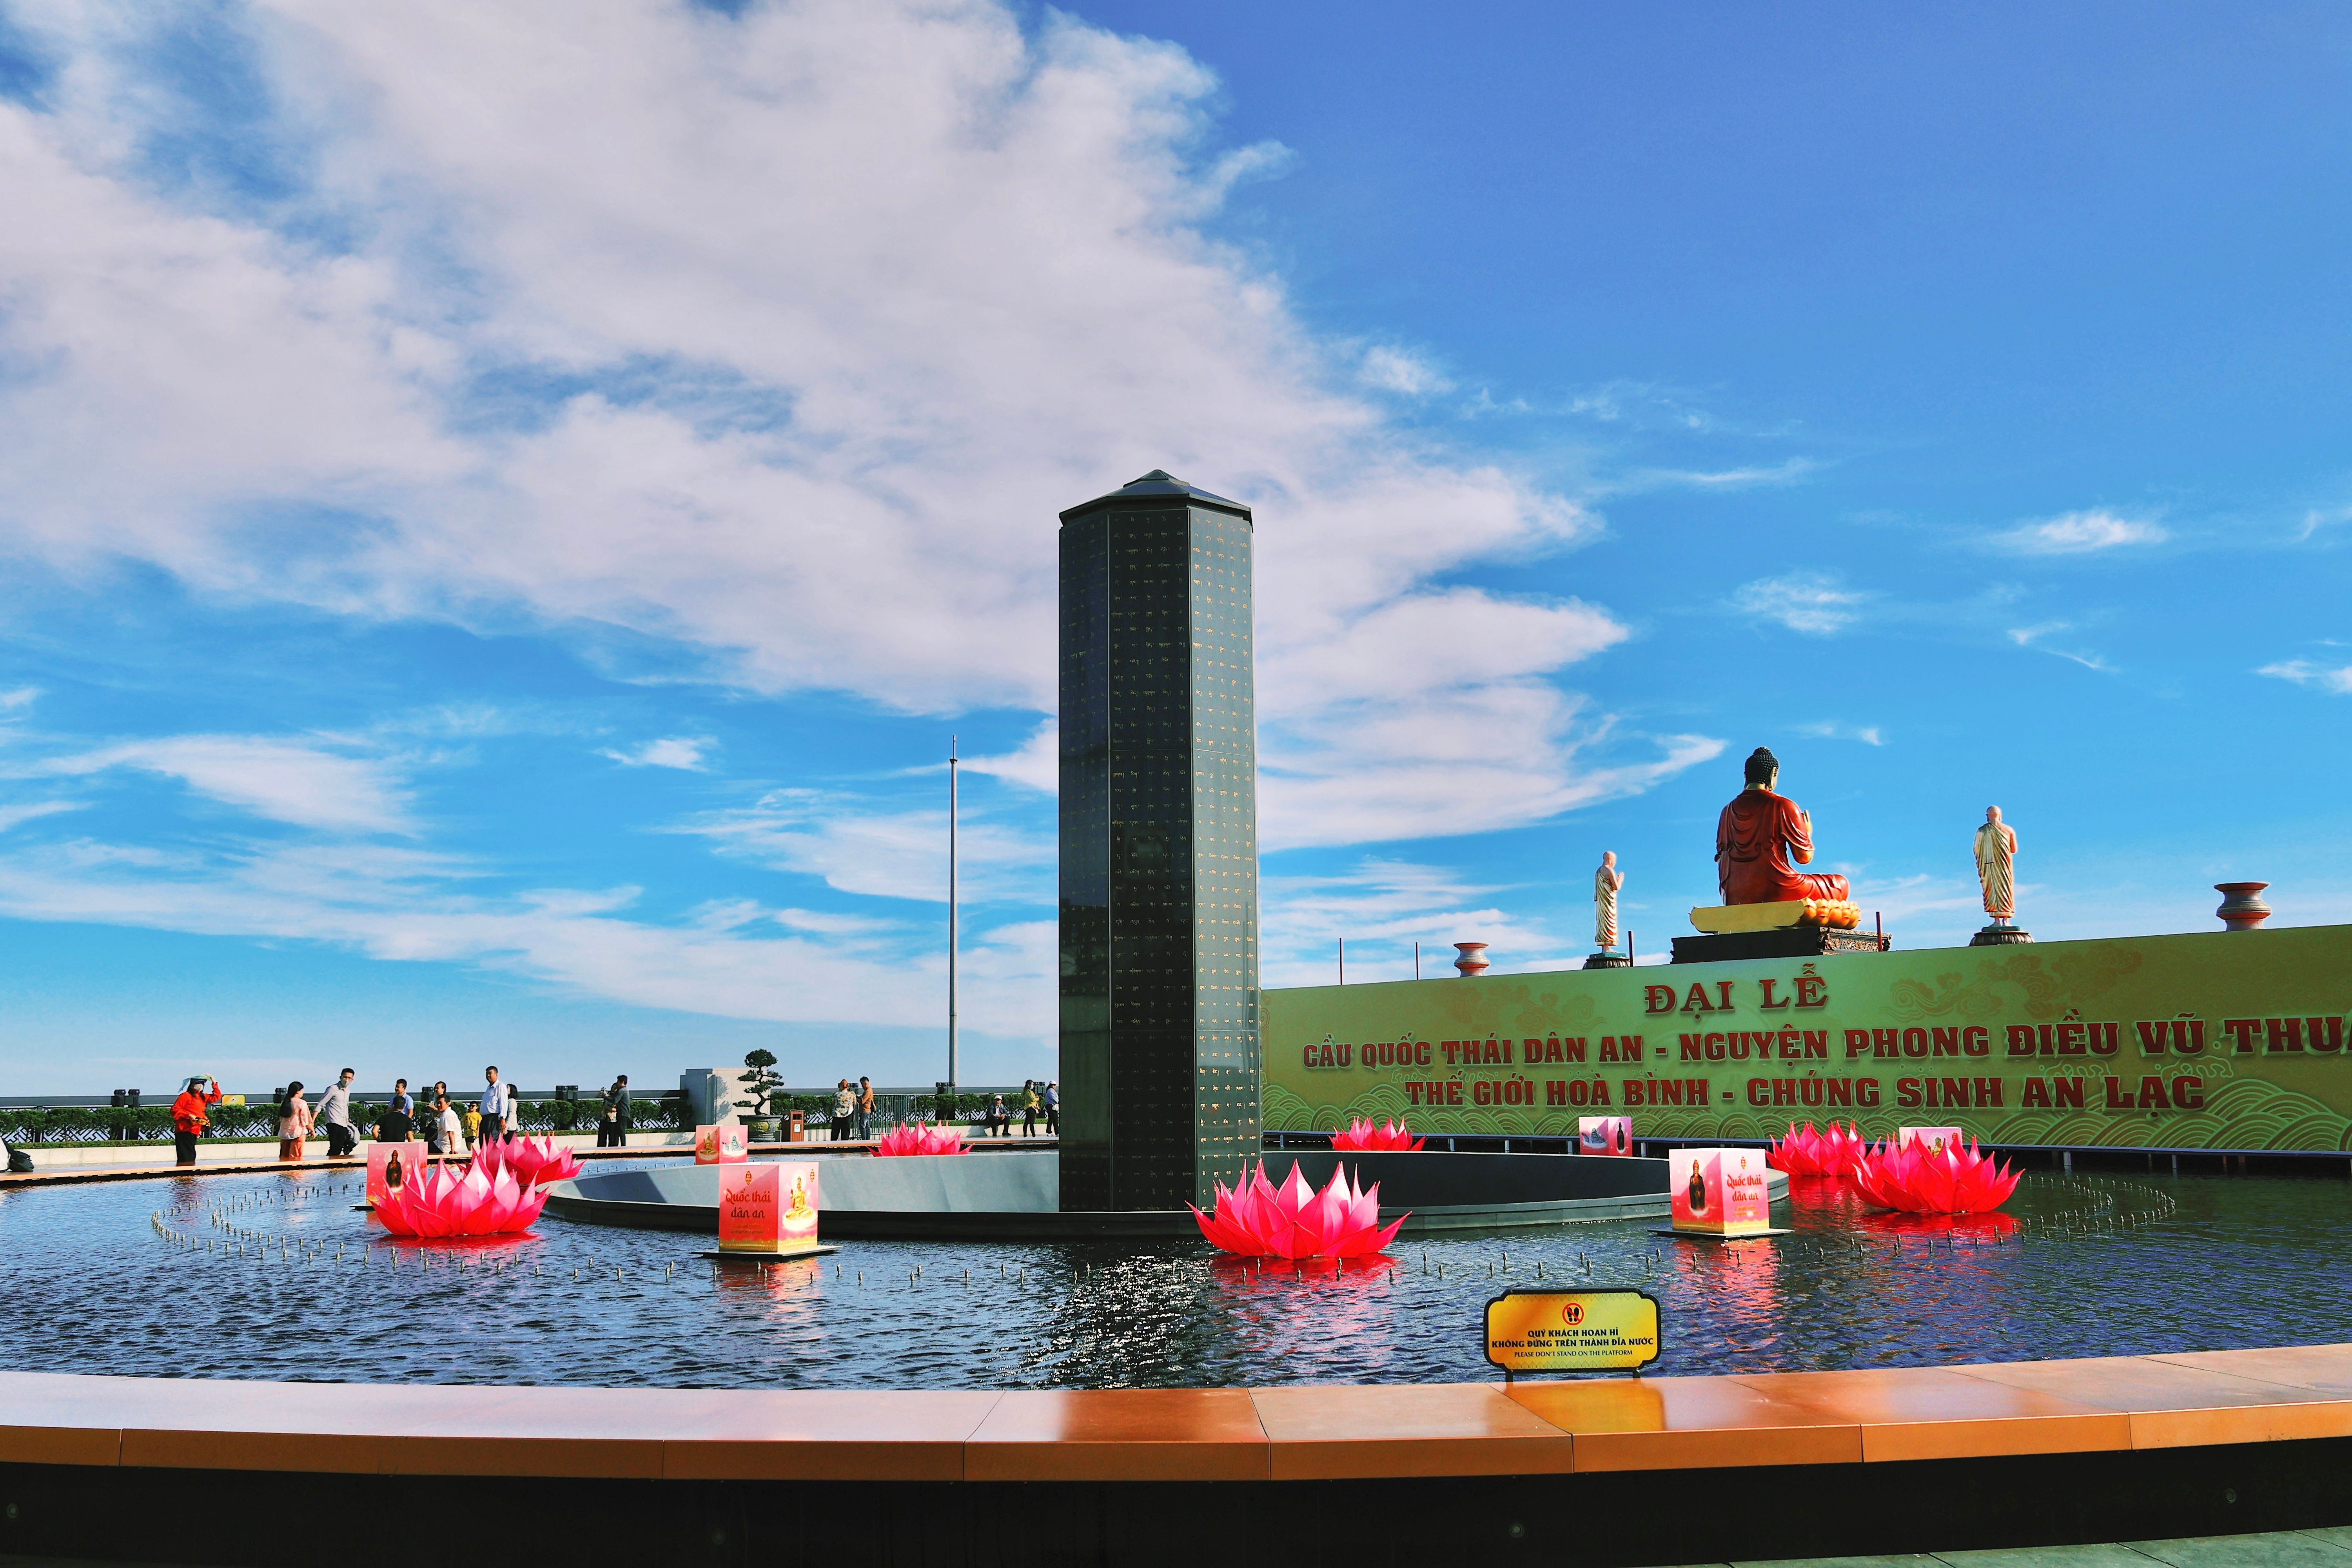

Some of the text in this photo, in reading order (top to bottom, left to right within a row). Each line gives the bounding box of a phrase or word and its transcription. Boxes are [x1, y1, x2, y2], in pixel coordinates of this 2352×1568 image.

[1645, 962, 1828, 1019] ĐẠI LỄ
[1303, 1034, 1352, 1067] CẦU
[1361, 1032, 1431, 1069] QUỐC
[1441, 1032, 1512, 1065] THÁI
[1523, 1032, 1586, 1063] DÂN
[1600, 1036, 1642, 1062] AN
[1679, 1024, 1828, 1067] NGUYỆN
[1844, 1026, 1989, 1058] PHONG
[2006, 1009, 2119, 1056] ĐIỀU
[2136, 1013, 2205, 1054] VŨ
[2224, 1015, 2352, 1052] THU
[1405, 1071, 1464, 1105] THẾ
[1473, 1073, 1534, 1106] GIỚI
[1546, 1073, 1611, 1106] HOÀ
[1622, 1071, 1709, 1107] BÌNH
[1746, 1070, 1880, 1108] CHÚNG
[1896, 1077, 2004, 1108] SINH
[2022, 1076, 2085, 1109] AN
[2104, 1075, 2204, 1118] LẠC
[725, 1188, 771, 1205] Quốc thái
[731, 1207, 765, 1219] dân an
[1548, 1328, 1579, 1337] KHÁCH
[1492, 1336, 1653, 1348] KHÔNG ĐỨNG TRÊN THÀNH ĐĨA NƯỚC
